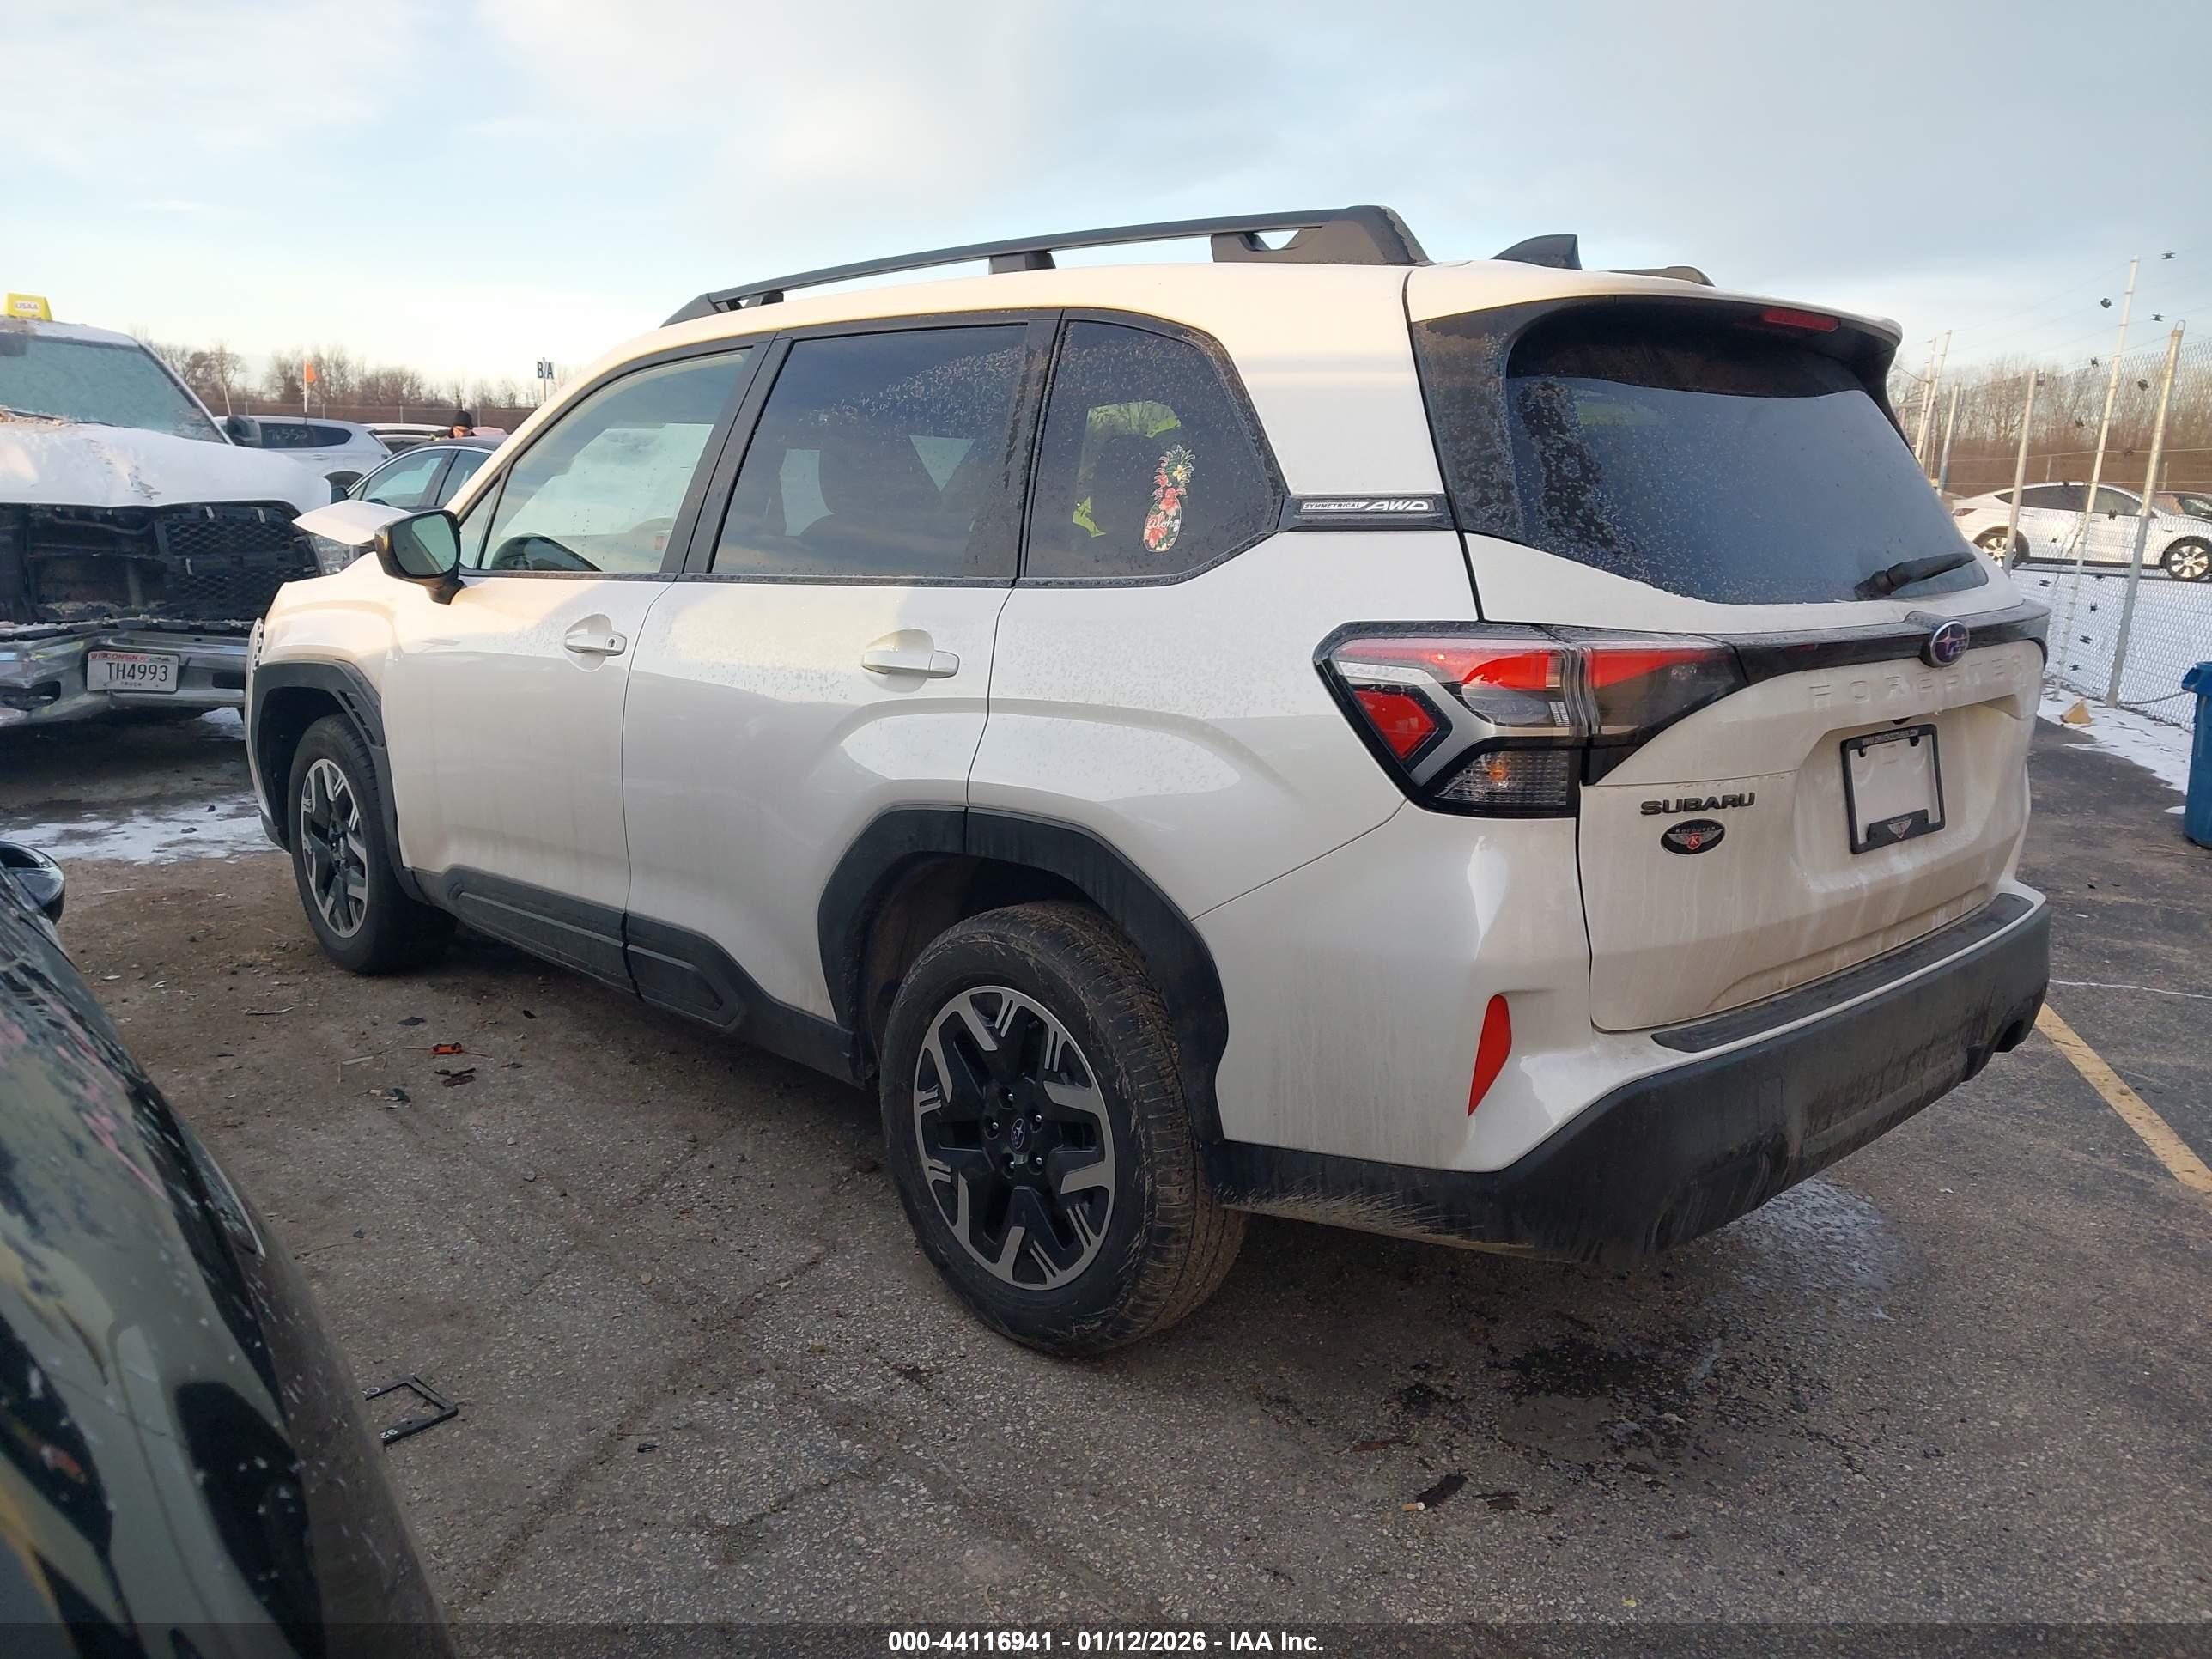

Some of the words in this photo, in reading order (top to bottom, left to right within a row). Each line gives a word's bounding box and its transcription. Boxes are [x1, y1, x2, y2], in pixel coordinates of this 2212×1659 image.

[537, 361, 544, 379] B
[546, 362, 554, 380] A
[1365, 501, 1430, 511] AWD
[106, 662, 168, 682] TH4993
[1640, 792, 1756, 815] SUBARU
